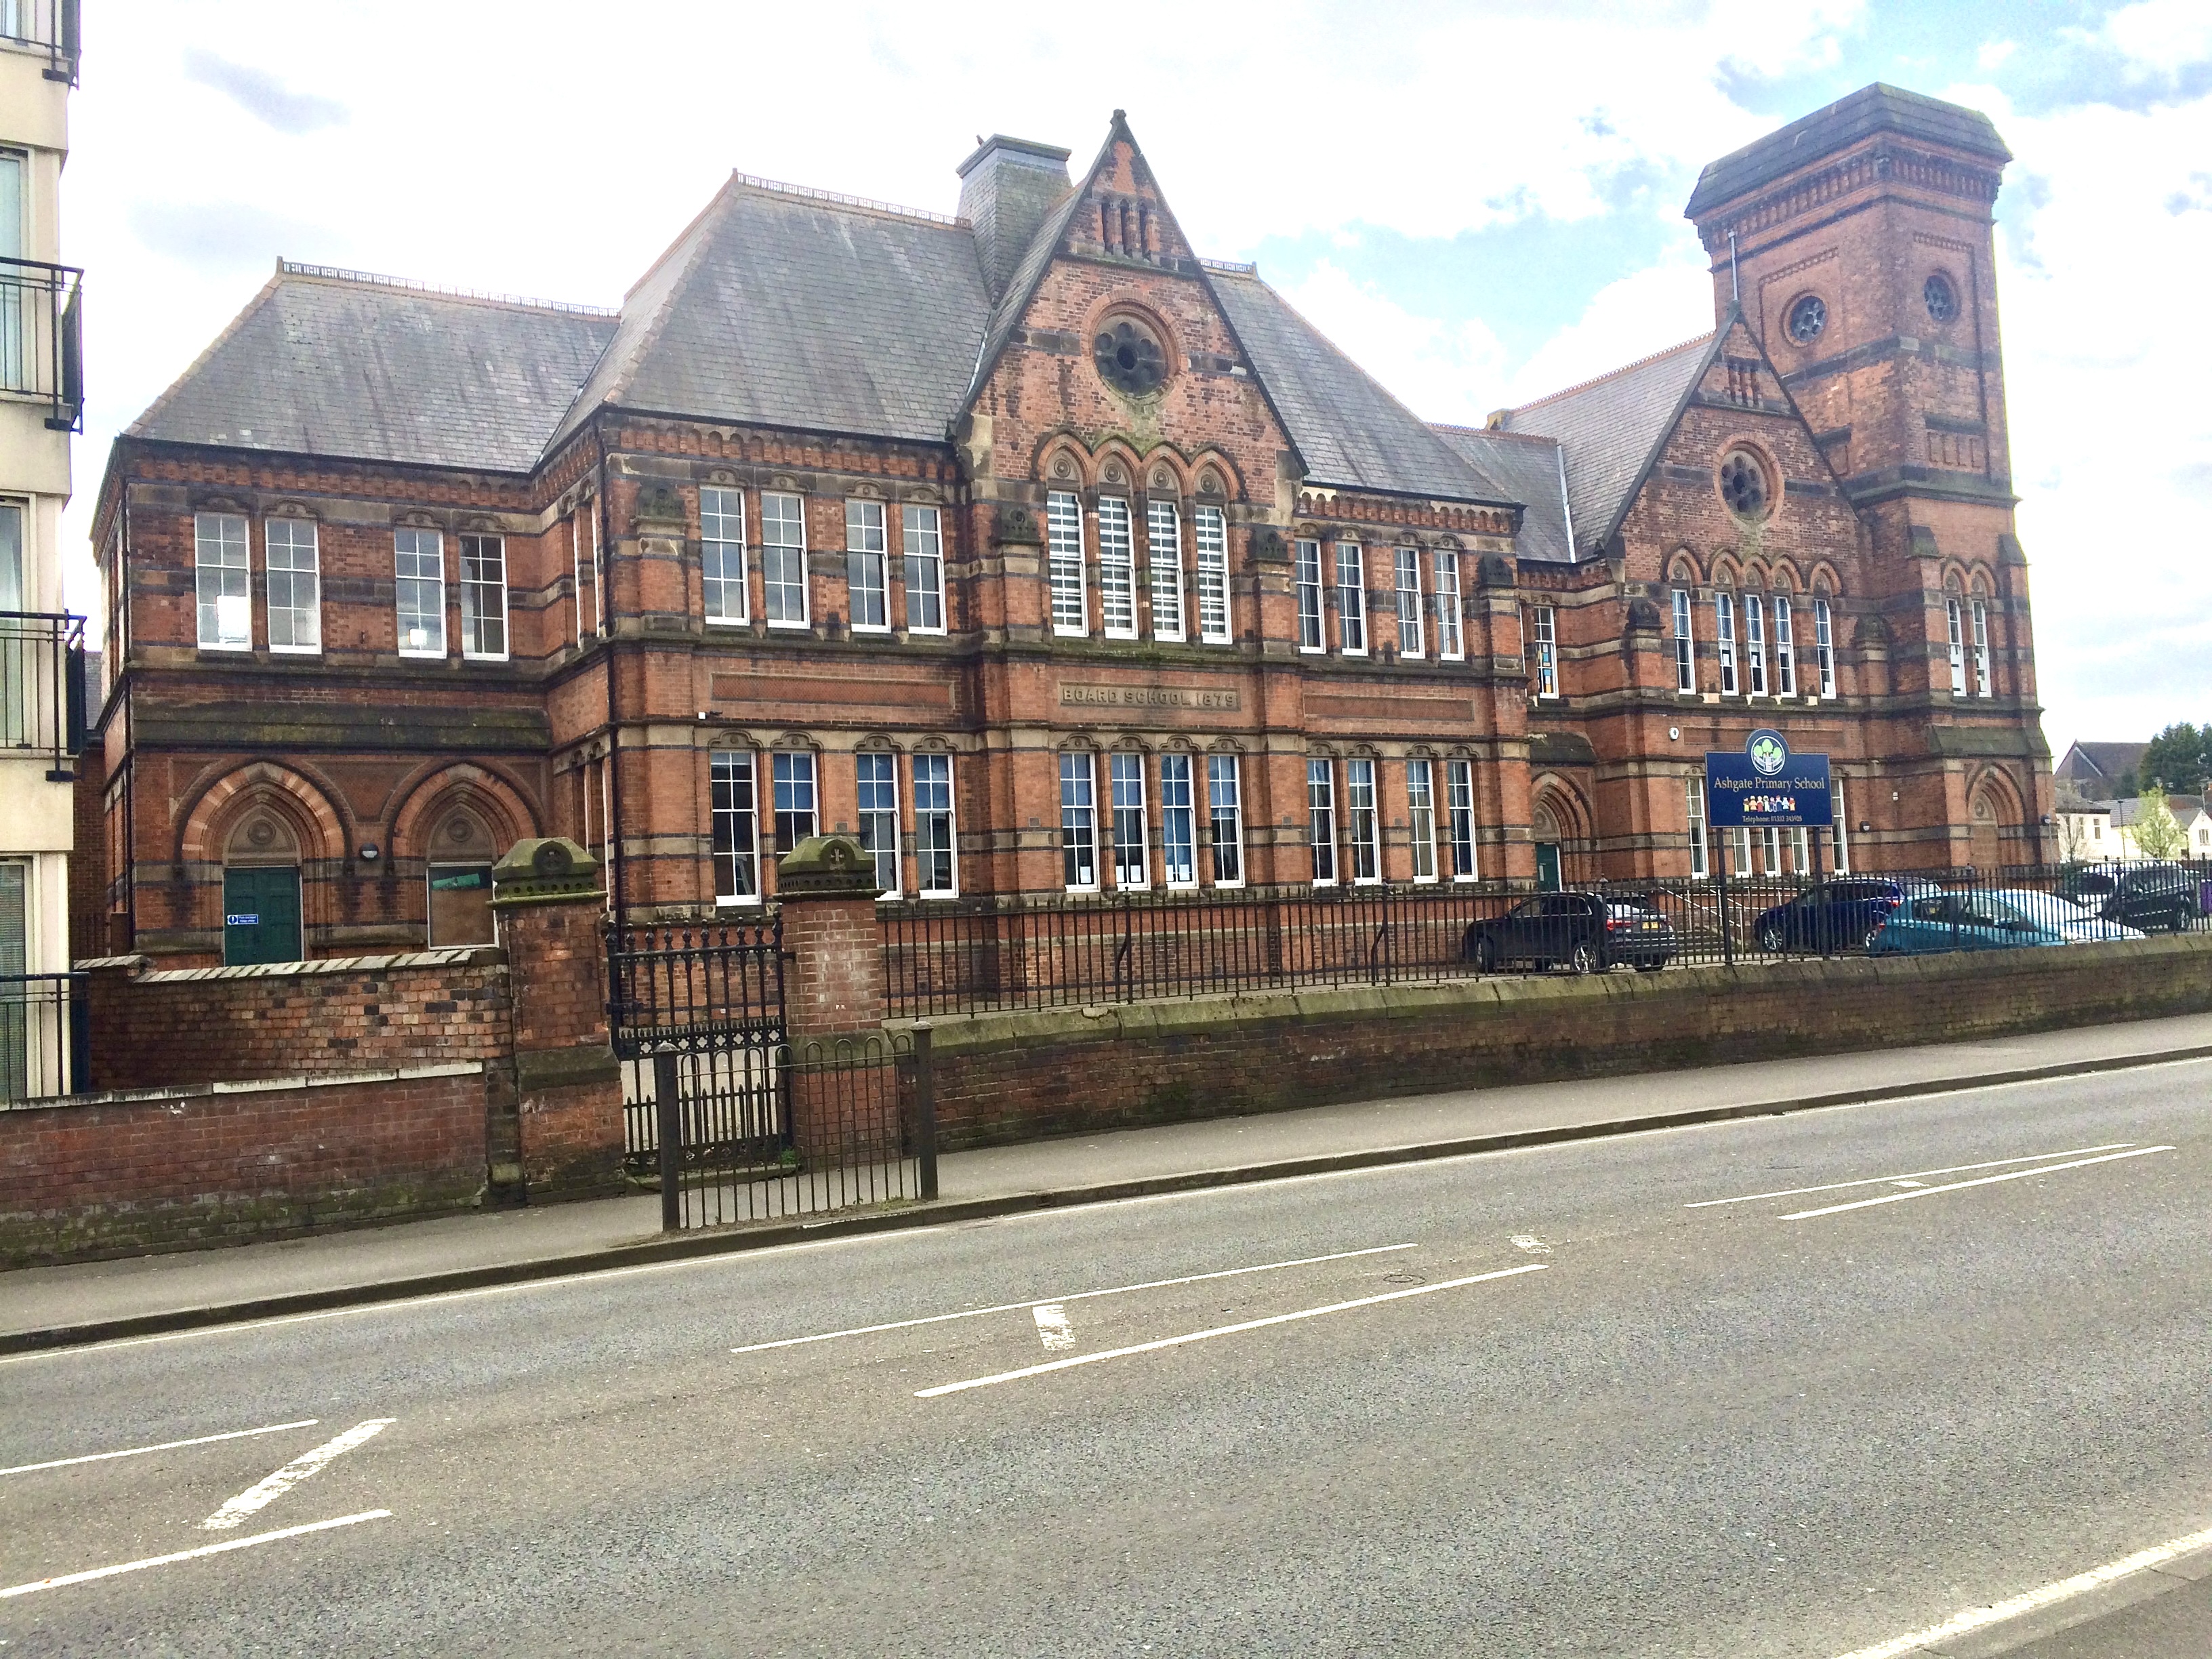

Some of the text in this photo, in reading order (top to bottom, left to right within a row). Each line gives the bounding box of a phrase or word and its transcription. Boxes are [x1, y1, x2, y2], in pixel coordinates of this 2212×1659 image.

[1062, 688, 1234, 707] BOARD SCHOOL 1879
[1714, 776, 1825, 792] Ashgate Primary School
